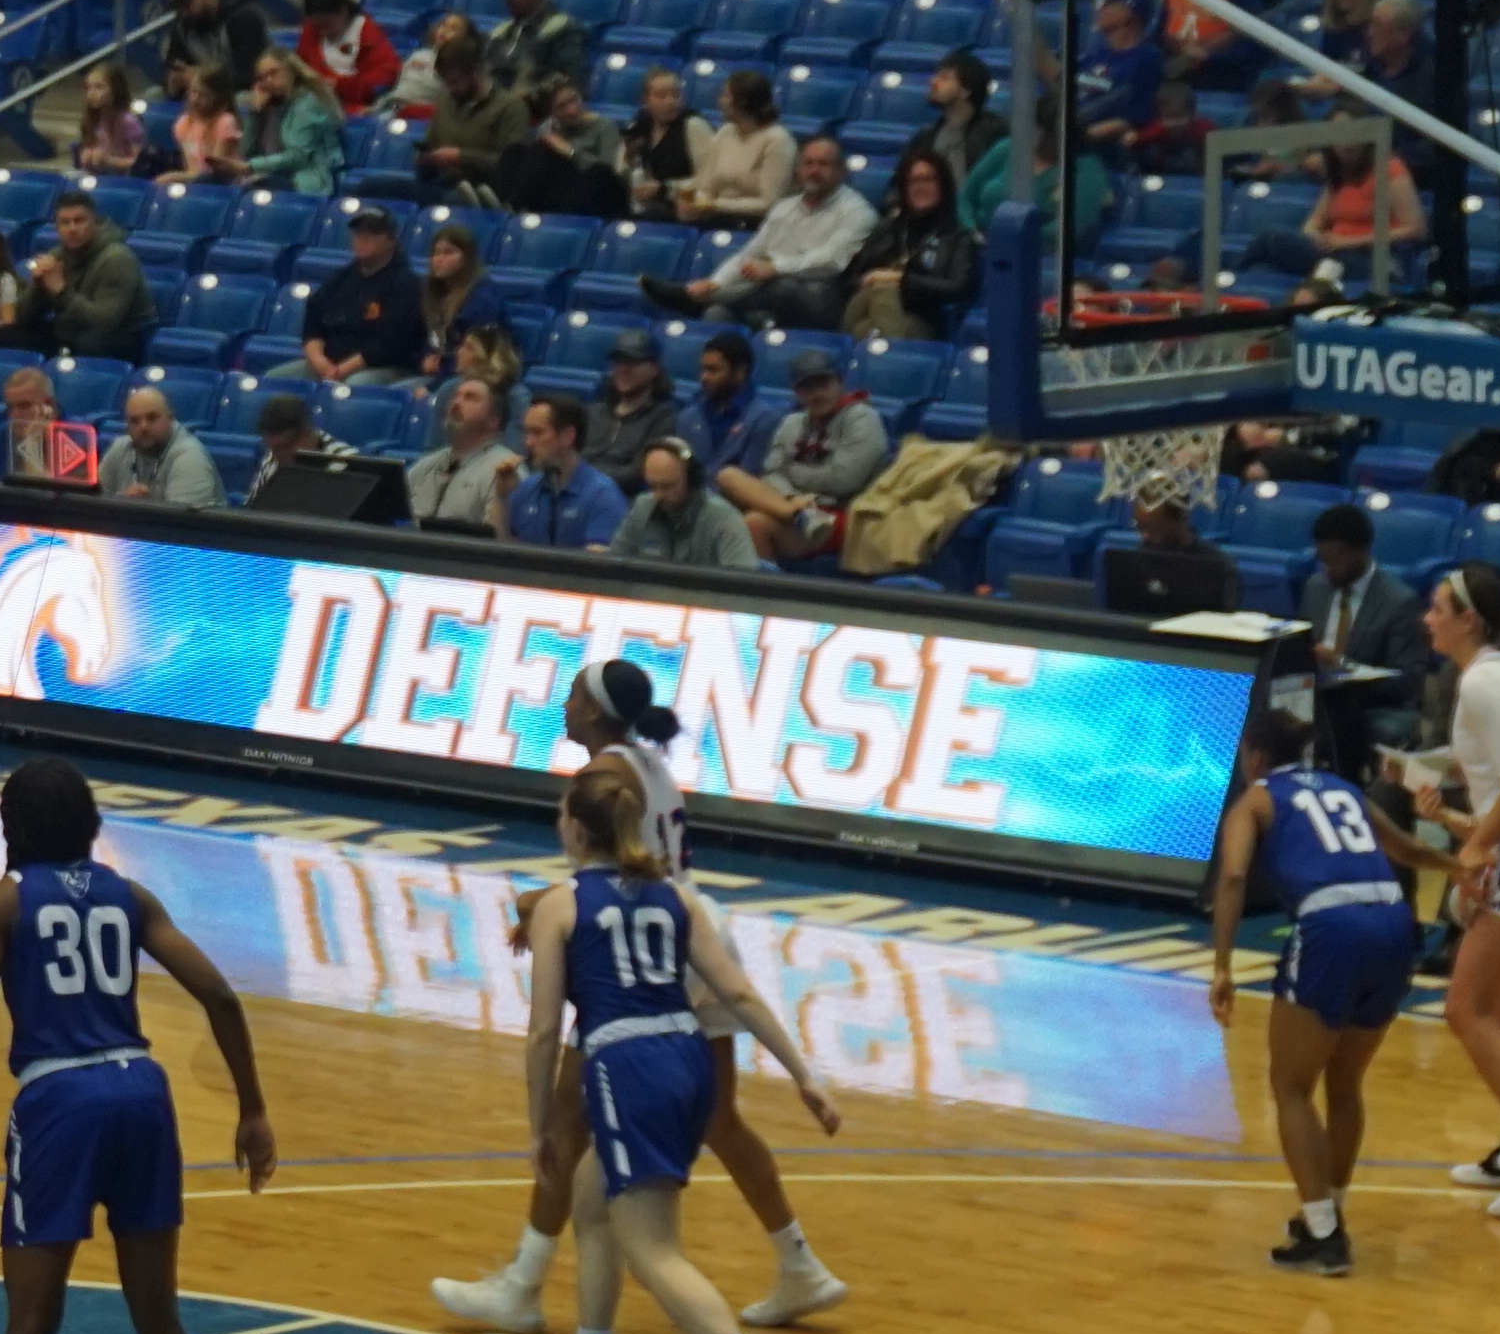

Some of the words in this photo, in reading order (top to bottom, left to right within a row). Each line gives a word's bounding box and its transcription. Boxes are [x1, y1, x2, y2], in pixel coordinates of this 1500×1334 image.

[242, 749, 315, 766] DAKTRONICS
[1291, 788, 1376, 855] 13
[36, 903, 133, 997] 30
[597, 903, 679, 989] 10
